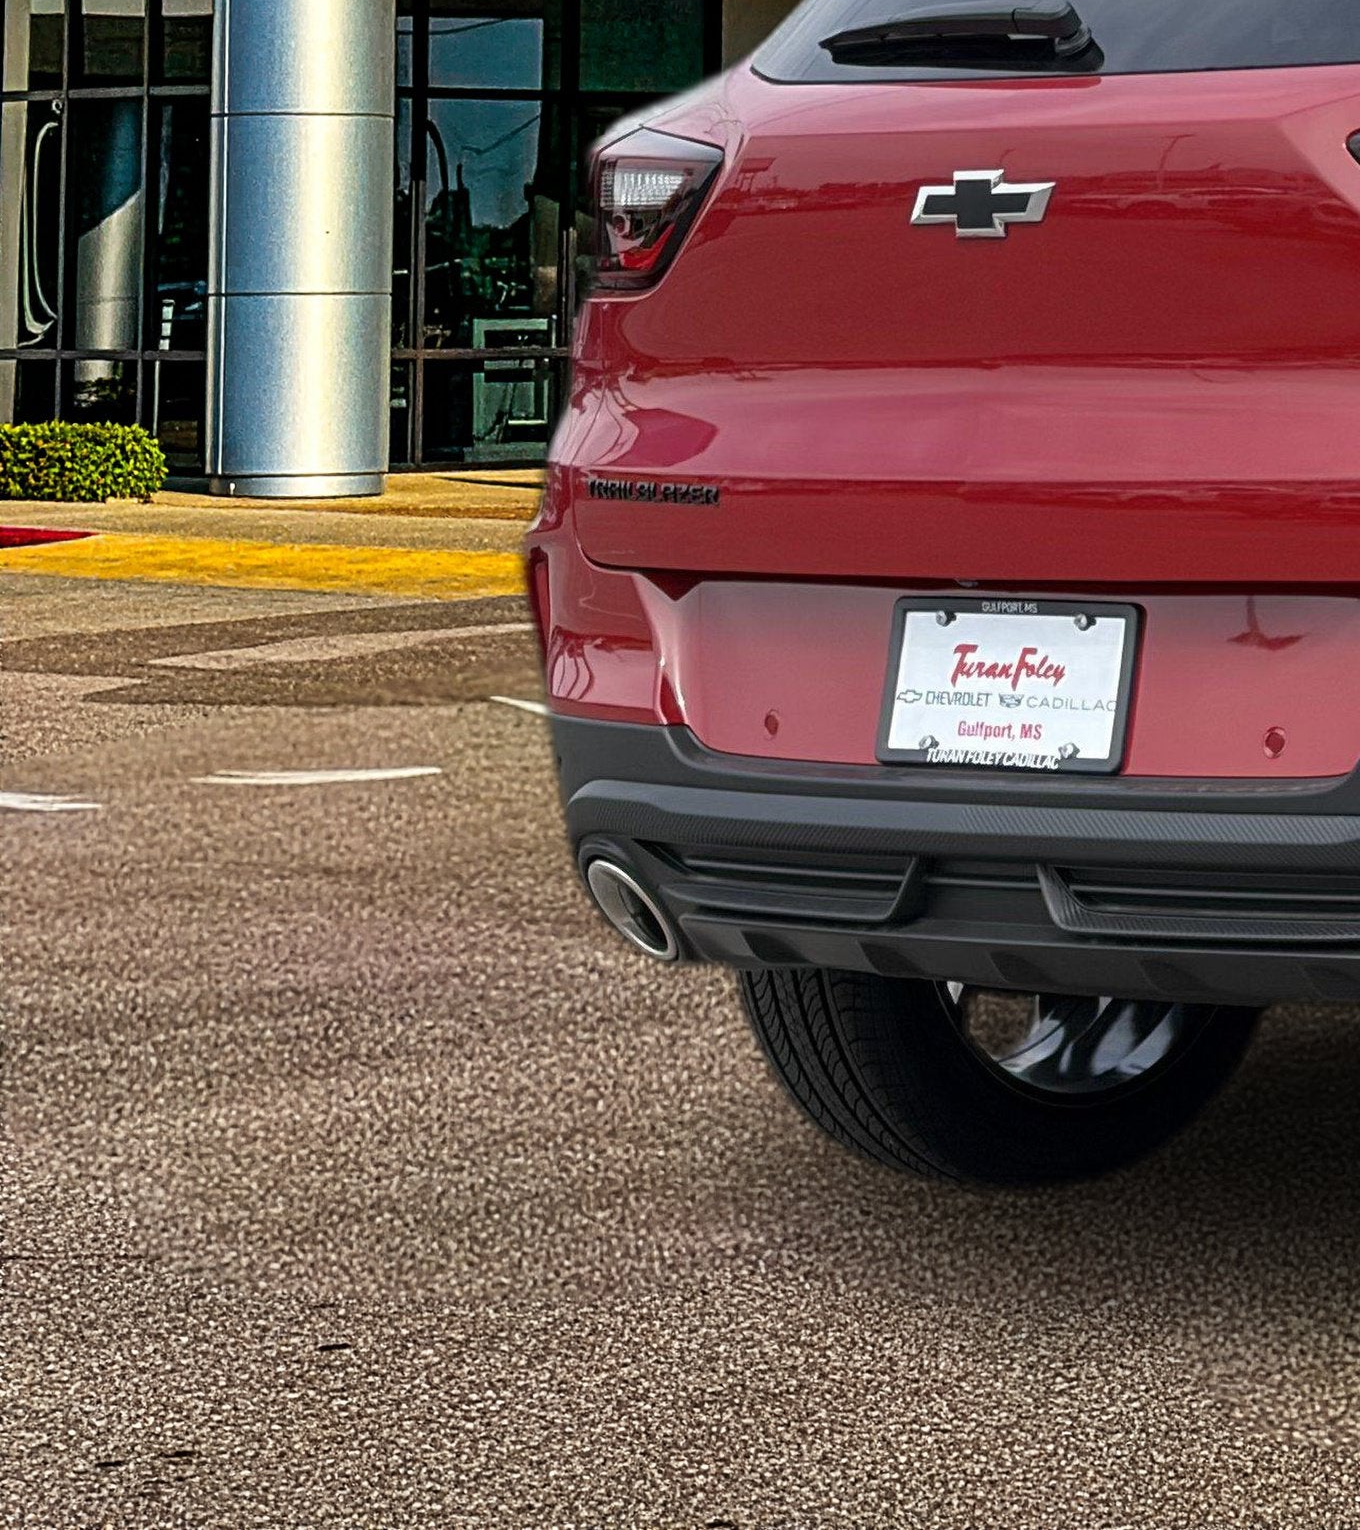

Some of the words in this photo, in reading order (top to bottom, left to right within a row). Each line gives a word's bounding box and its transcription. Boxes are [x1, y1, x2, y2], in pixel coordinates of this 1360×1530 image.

[951, 643, 1013, 688] Turan
[1011, 647, 1066, 692] Foley
[925, 690, 992, 708] CHEVROLET
[1026, 696, 1118, 712] CADILLAC
[957, 720, 1015, 741] Gulfport,
[1019, 723, 1043, 740] MS
